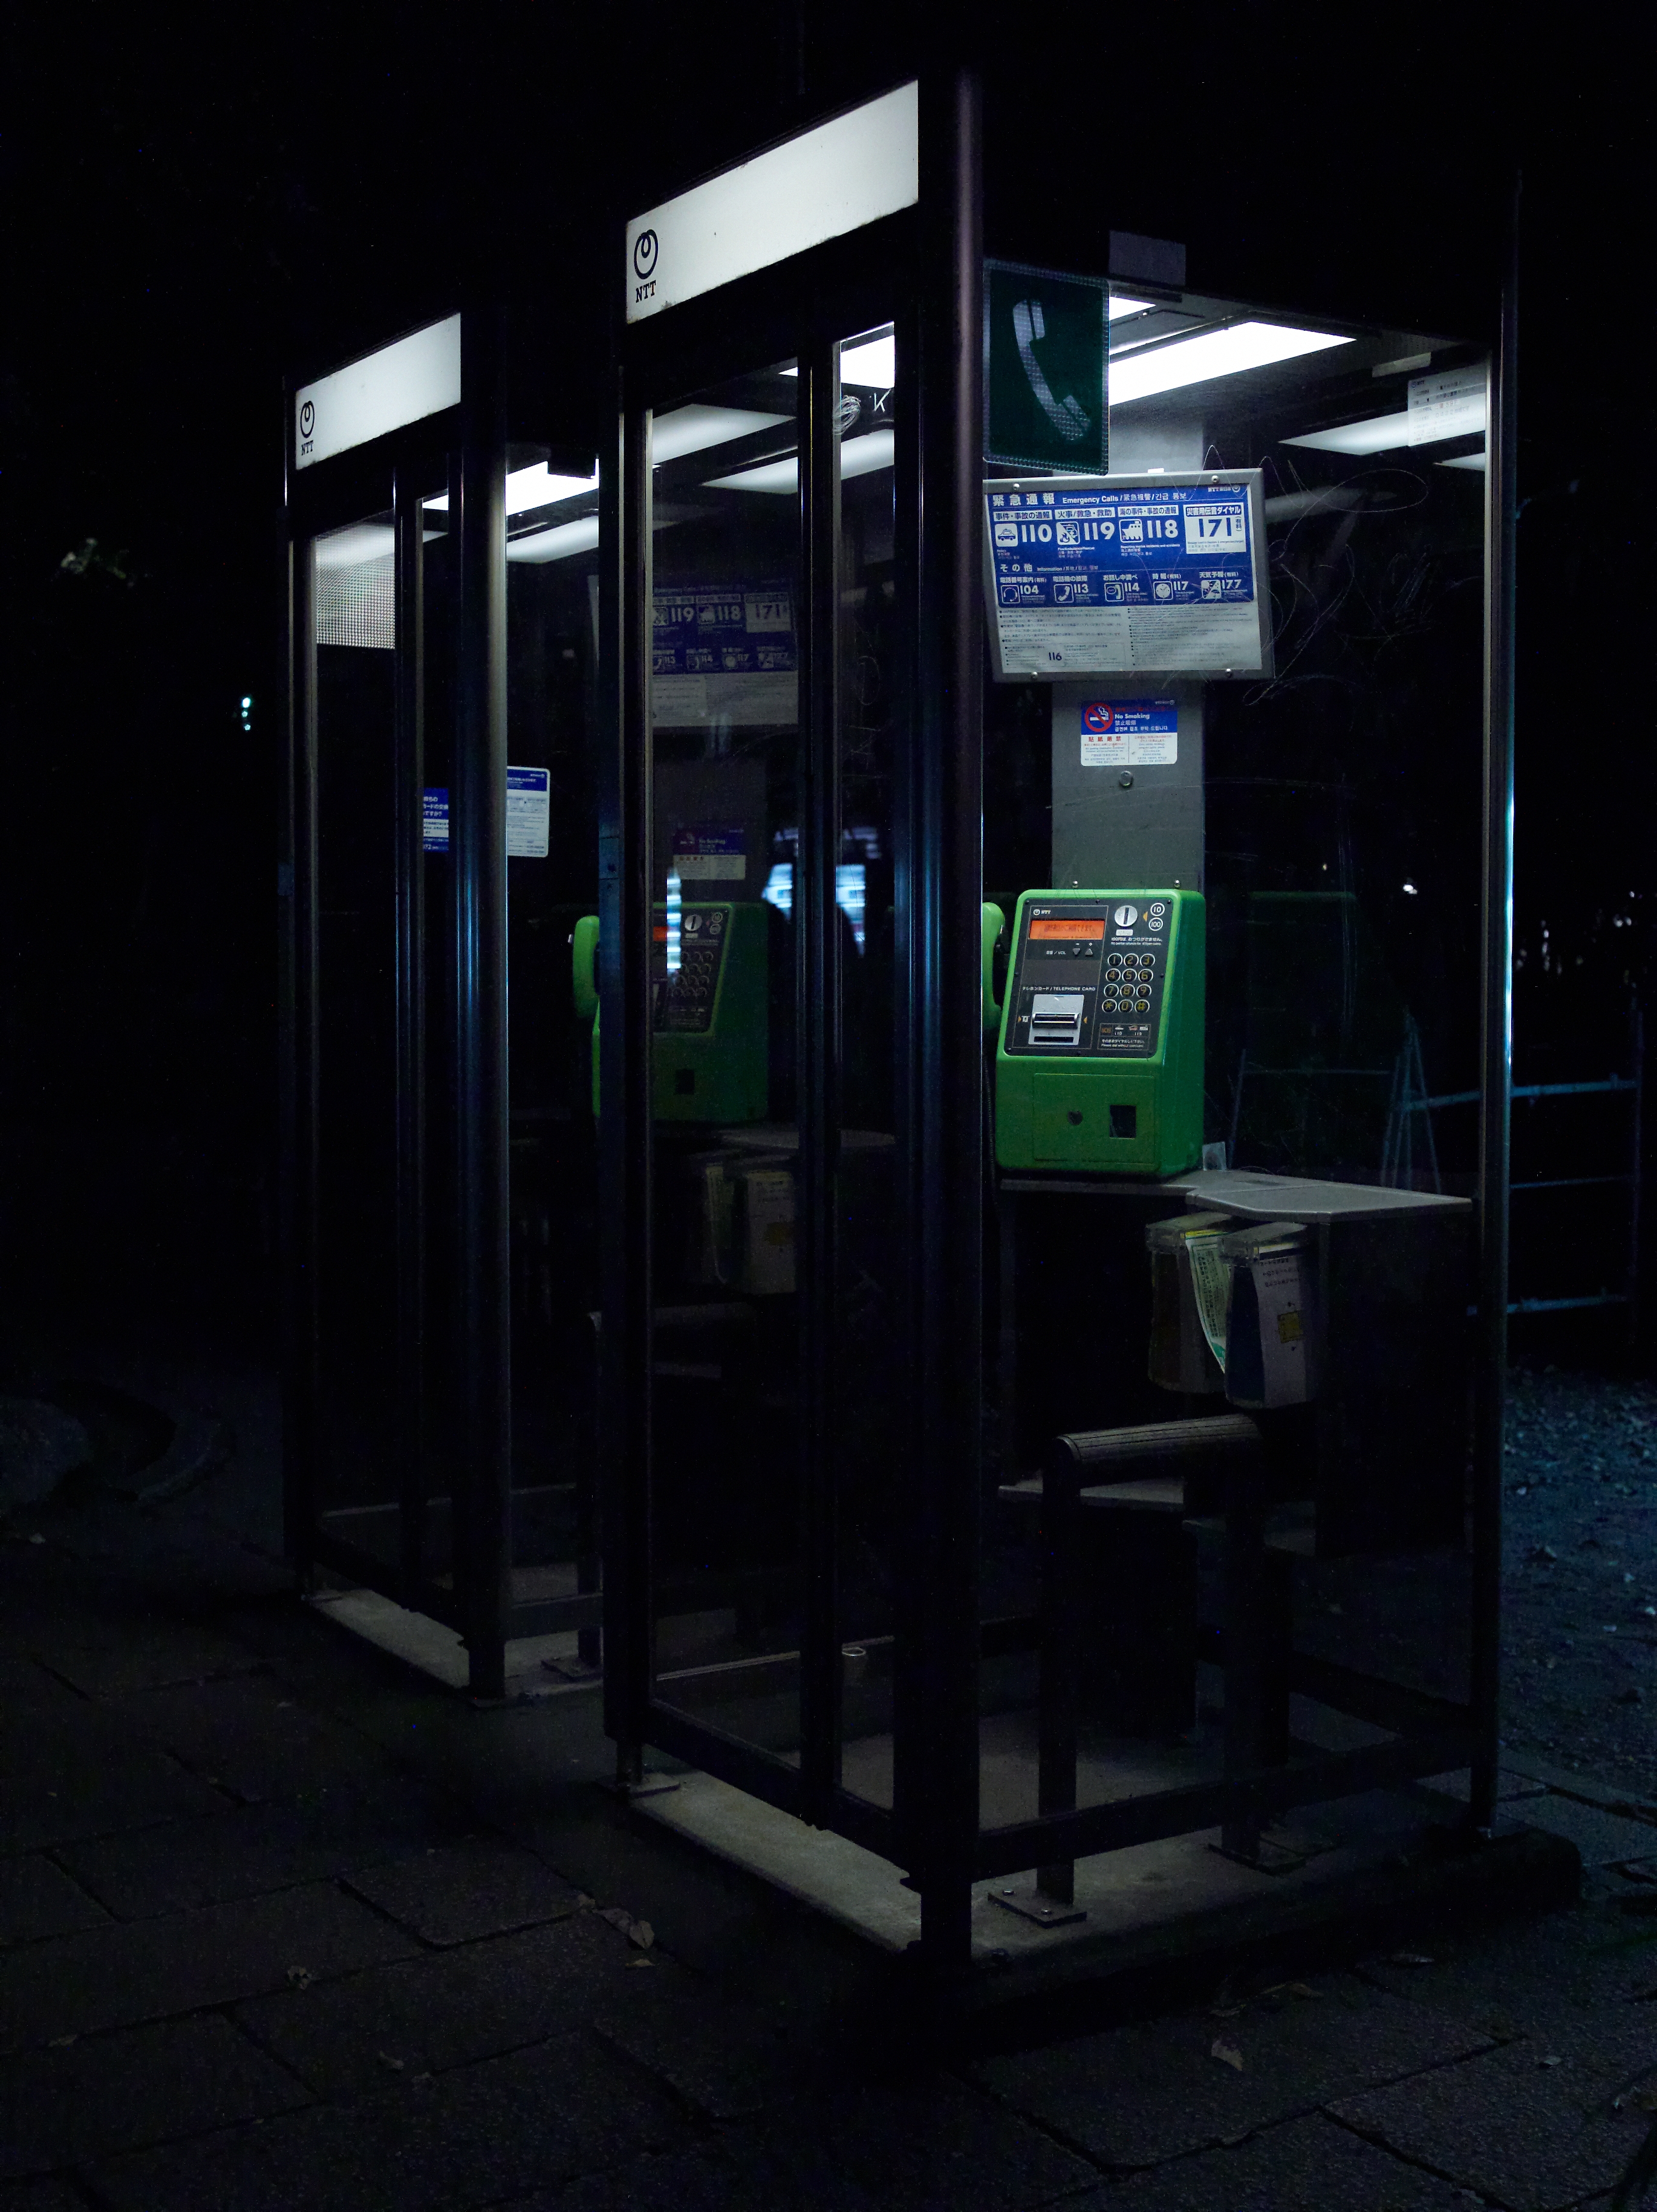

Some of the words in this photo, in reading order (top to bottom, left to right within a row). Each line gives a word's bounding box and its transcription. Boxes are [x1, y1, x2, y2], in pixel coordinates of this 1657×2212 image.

[636, 279, 656, 303] NTT
[301, 440, 314, 456] NTT
[992, 493, 1055, 506] 緊急通報
[1083, 521, 1115, 541] 119
[1147, 519, 1179, 538] 118
[1199, 517, 1232, 538] 171
[1021, 524, 1052, 542] 110
[1000, 564, 1032, 572] その他
[1073, 584, 1089, 593] 113
[1124, 582, 1139, 592] 114
[1173, 581, 1189, 591] 117
[1222, 579, 1242, 589] 177
[1020, 585, 1039, 594] 104
[671, 607, 694, 622] 119
[718, 605, 741, 620] 118
[755, 603, 780, 619] 171
[1049, 652, 1062, 661] 116
[1113, 955, 1116, 964] 1
[1127, 955, 1133, 964] 2
[1142, 955, 1150, 965] 3
[1125, 971, 1132, 980] 5
[1141, 971, 1148, 980] 6
[1108, 986, 1114, 995] 7
[1123, 986, 1130, 995] 8
[1140, 986, 1147, 995] 9
[1121, 1001, 1128, 1010] 0
